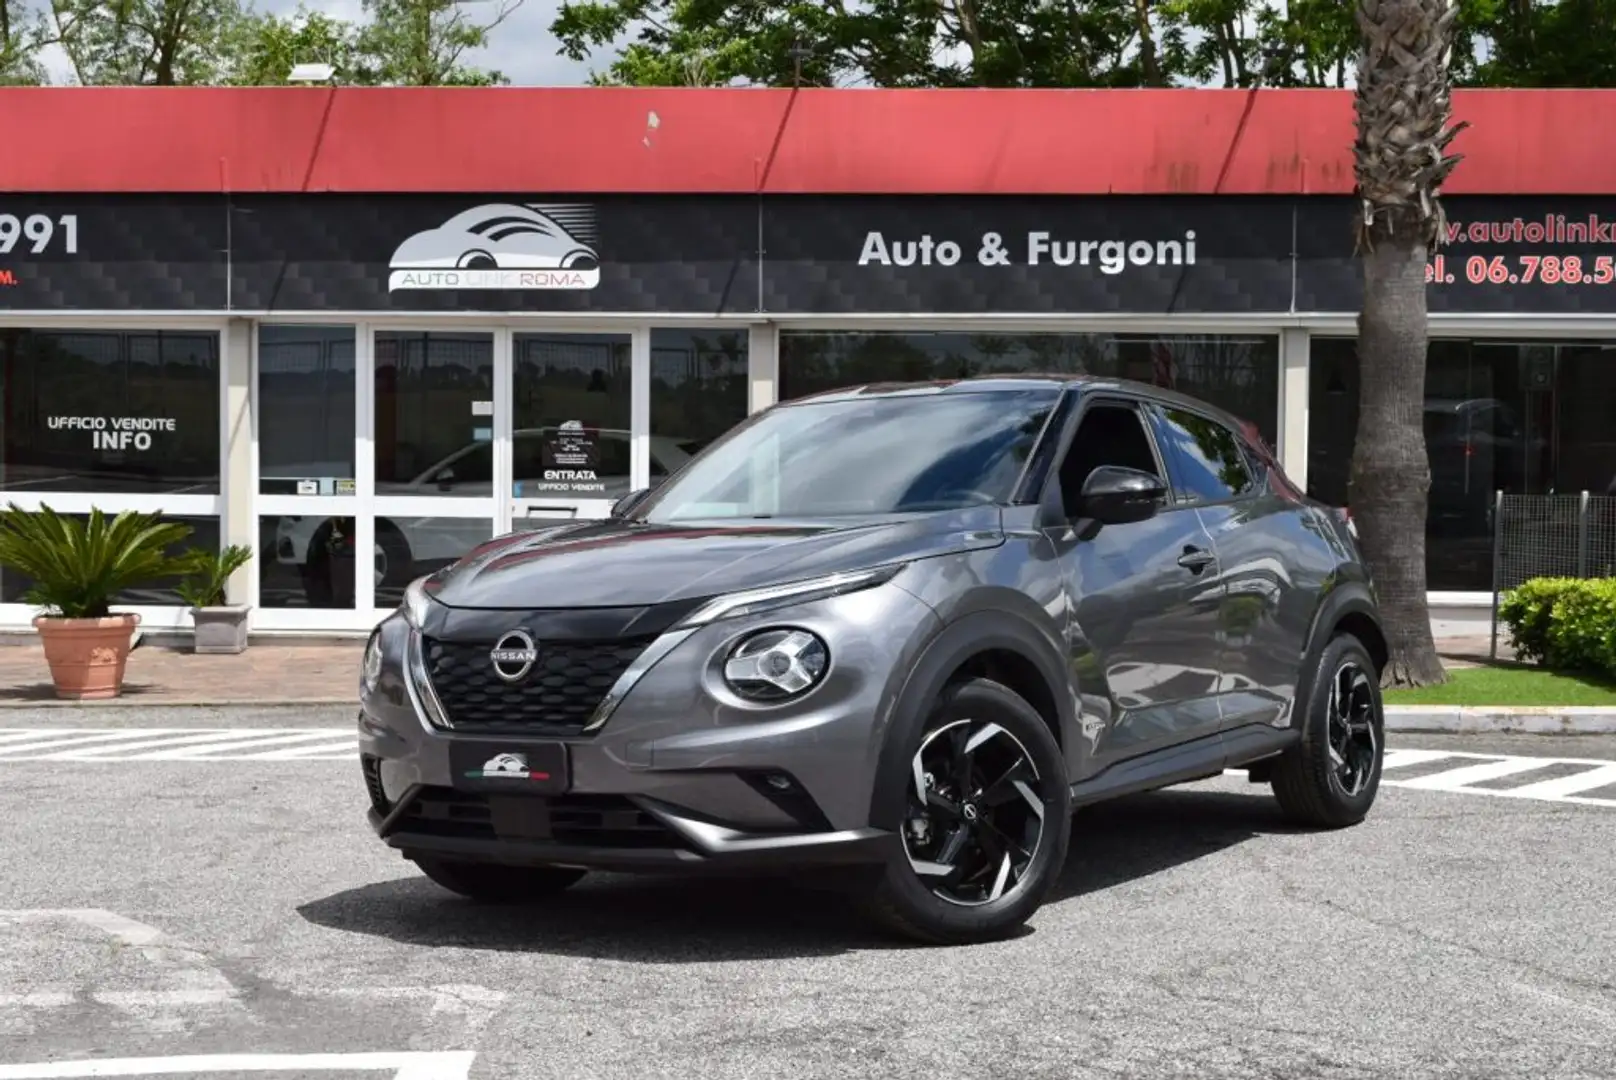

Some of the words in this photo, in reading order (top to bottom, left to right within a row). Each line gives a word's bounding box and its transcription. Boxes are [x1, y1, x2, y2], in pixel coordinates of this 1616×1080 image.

[0, 214, 77, 254] 991
[858, 231, 962, 266] Auto
[977, 231, 1011, 267] &
[1028, 230, 1196, 274] Furgoni
[1466, 255, 1616, 285] 06.788.5
[402, 272, 459, 286] AUTO
[520, 272, 586, 286] ROMA
[47, 416, 106, 430] UFFICIO
[111, 417, 176, 431] VENDITE
[93, 431, 151, 450] INFO
[544, 470, 597, 480] ENTRATA
[538, 483, 569, 491] UFFICIO
[571, 483, 605, 492] VENDITE
[491, 650, 536, 661] NISSAN
